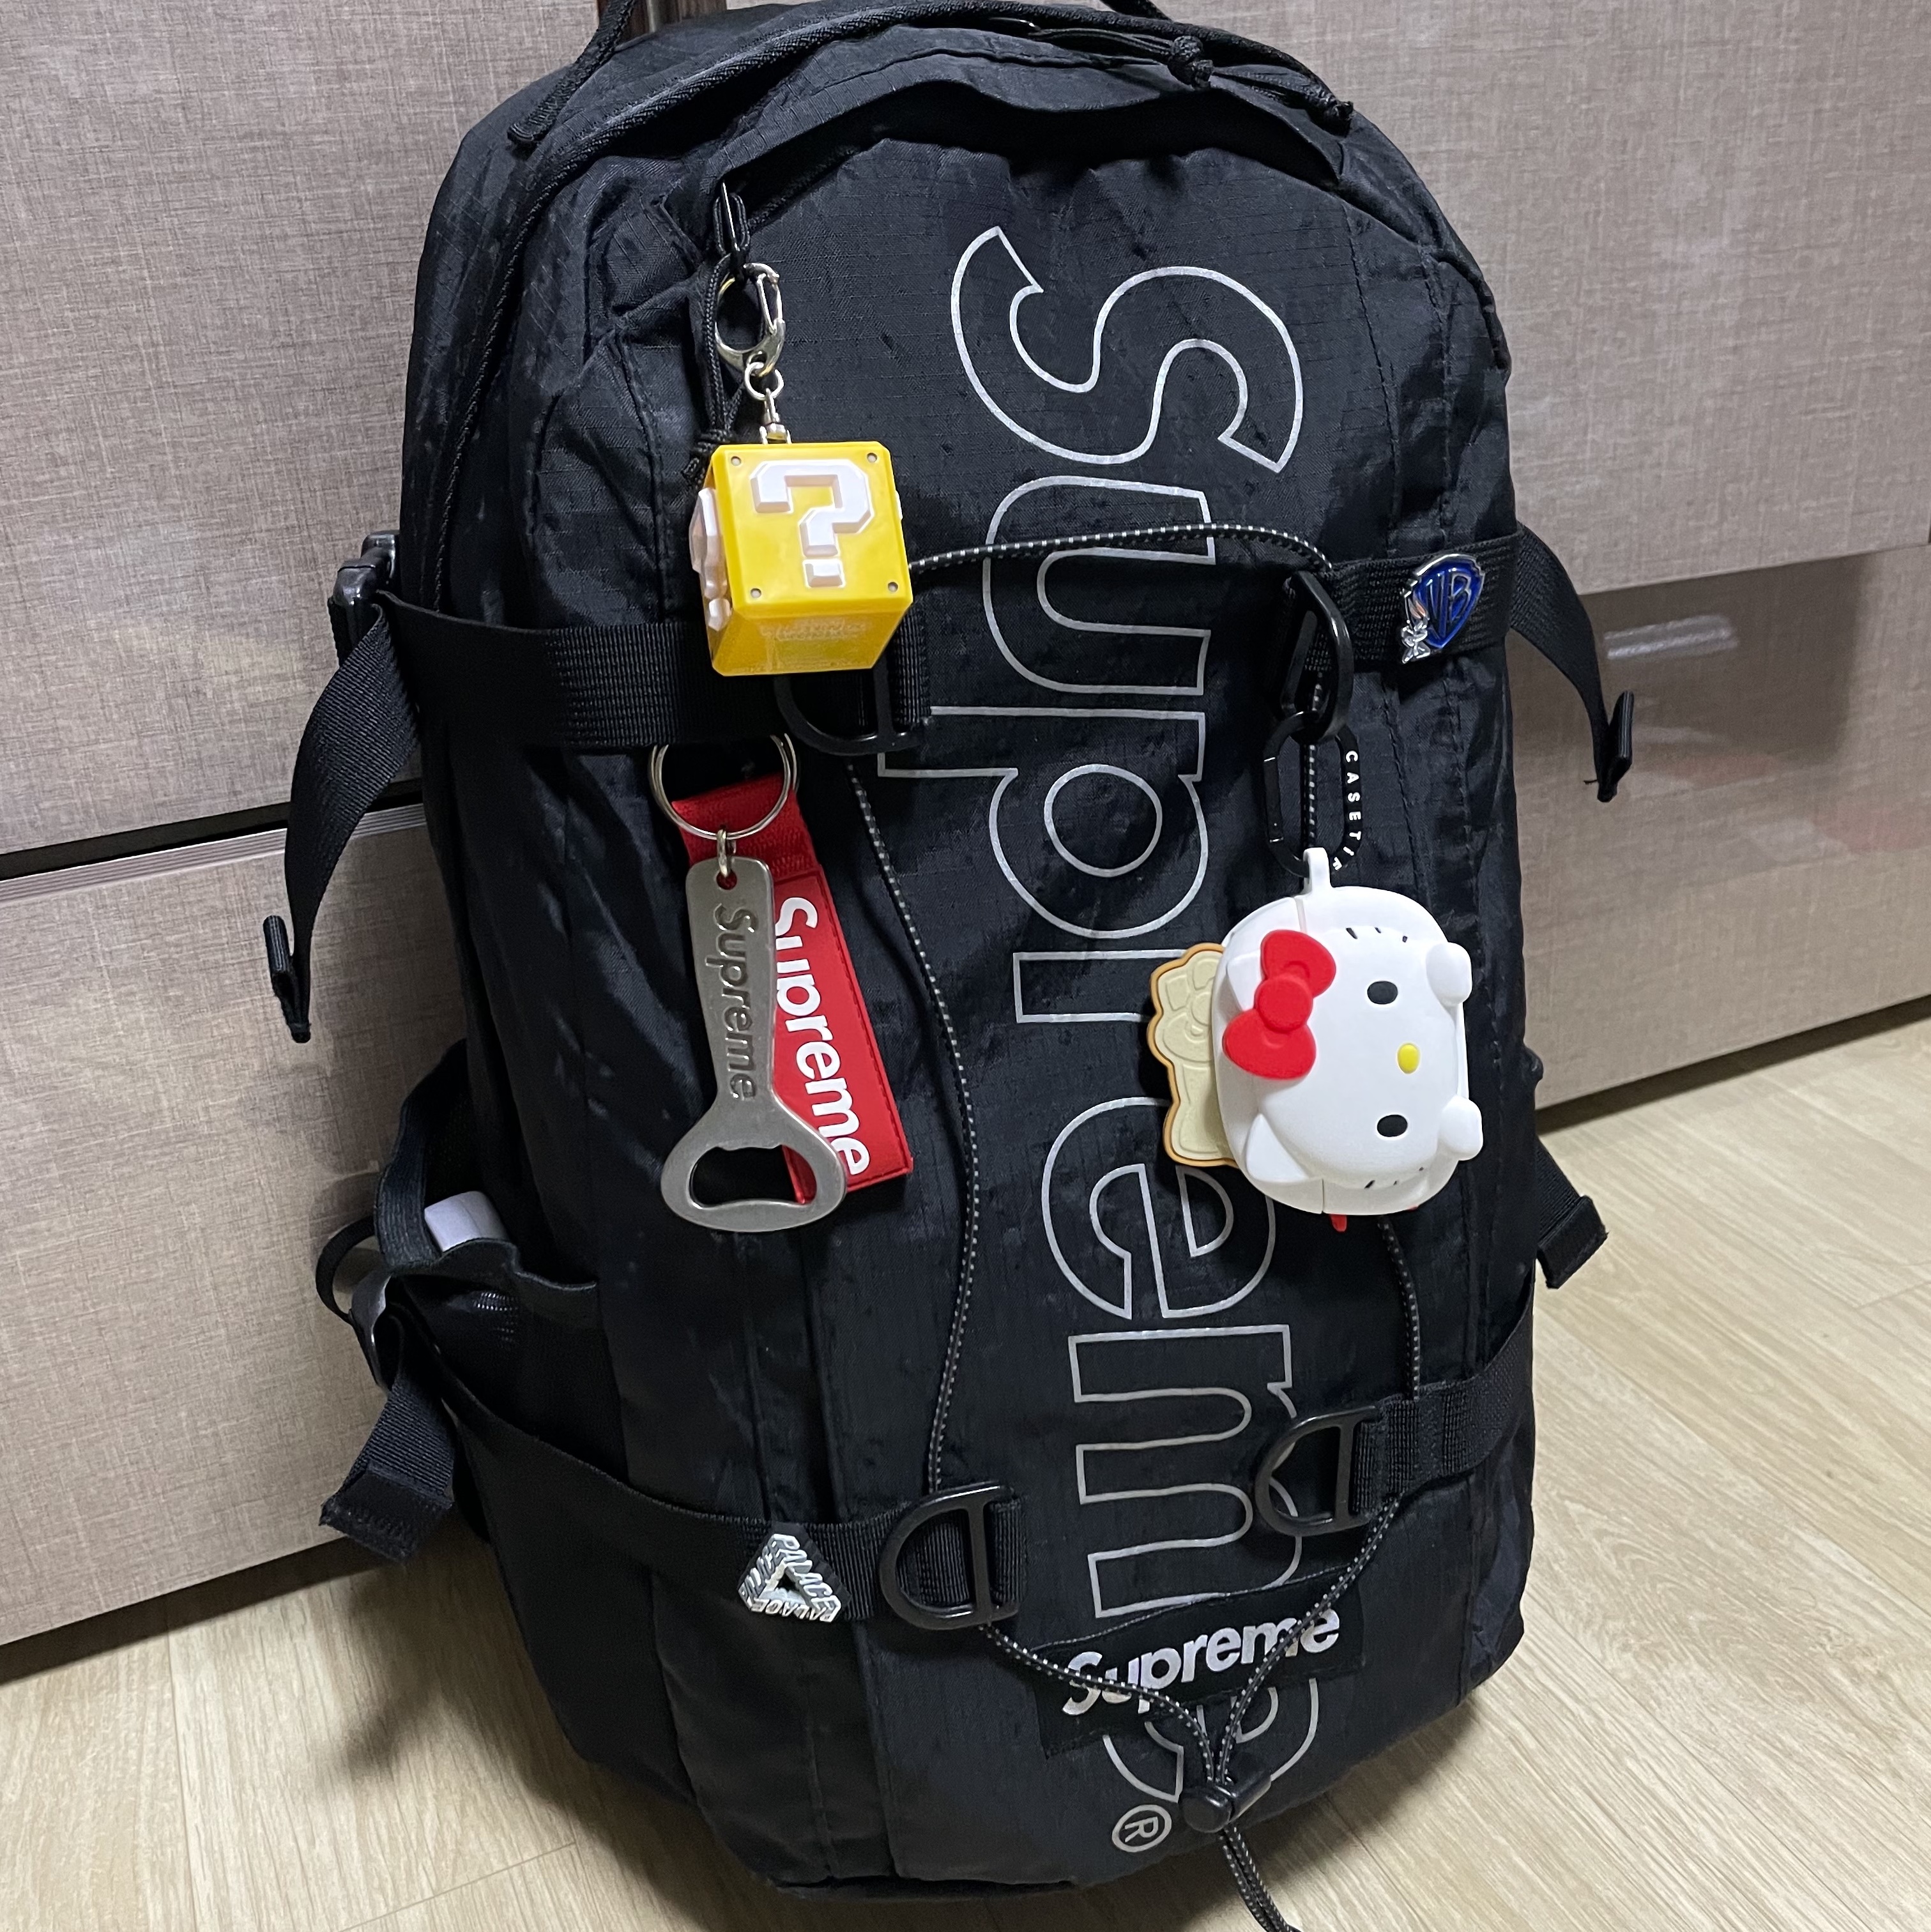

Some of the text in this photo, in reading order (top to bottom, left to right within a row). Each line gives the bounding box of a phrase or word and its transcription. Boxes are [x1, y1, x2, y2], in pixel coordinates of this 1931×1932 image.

[1416, 566, 1473, 641] WB
[704, 902, 759, 1101] Supreme
[775, 895, 871, 1176] Supreme
[771, 1533, 841, 1616] PALACE
[1062, 1608, 1341, 1716] Supreme
